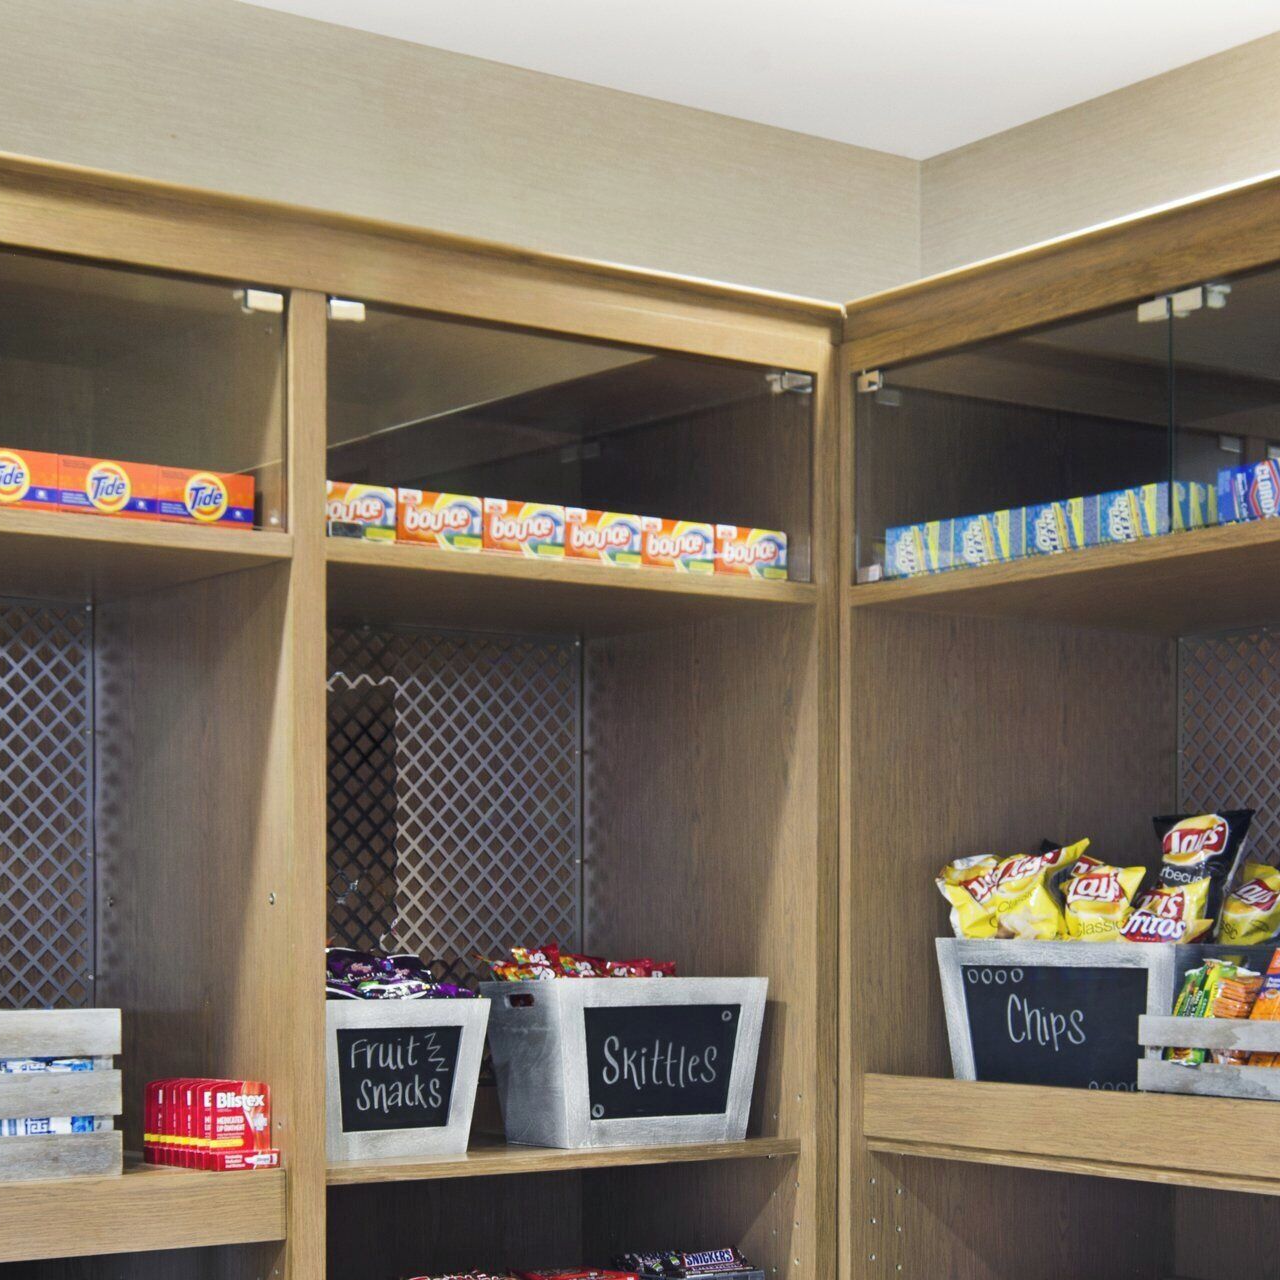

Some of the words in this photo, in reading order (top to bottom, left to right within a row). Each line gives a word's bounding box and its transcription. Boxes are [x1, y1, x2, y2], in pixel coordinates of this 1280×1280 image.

[90, 475, 126, 498] Tide
[189, 485, 223, 508] Tide
[1254, 464, 1279, 518] CLOROX
[1171, 823, 1224, 854] Lay's
[1006, 993, 1086, 1051] Chips
[350, 1035, 421, 1070] Fruit
[602, 1036, 717, 1090] Skittles
[216, 1091, 266, 1112] Blistex
[356, 1074, 442, 1113] Snacks
[685, 1248, 733, 1267] SNICKERS
